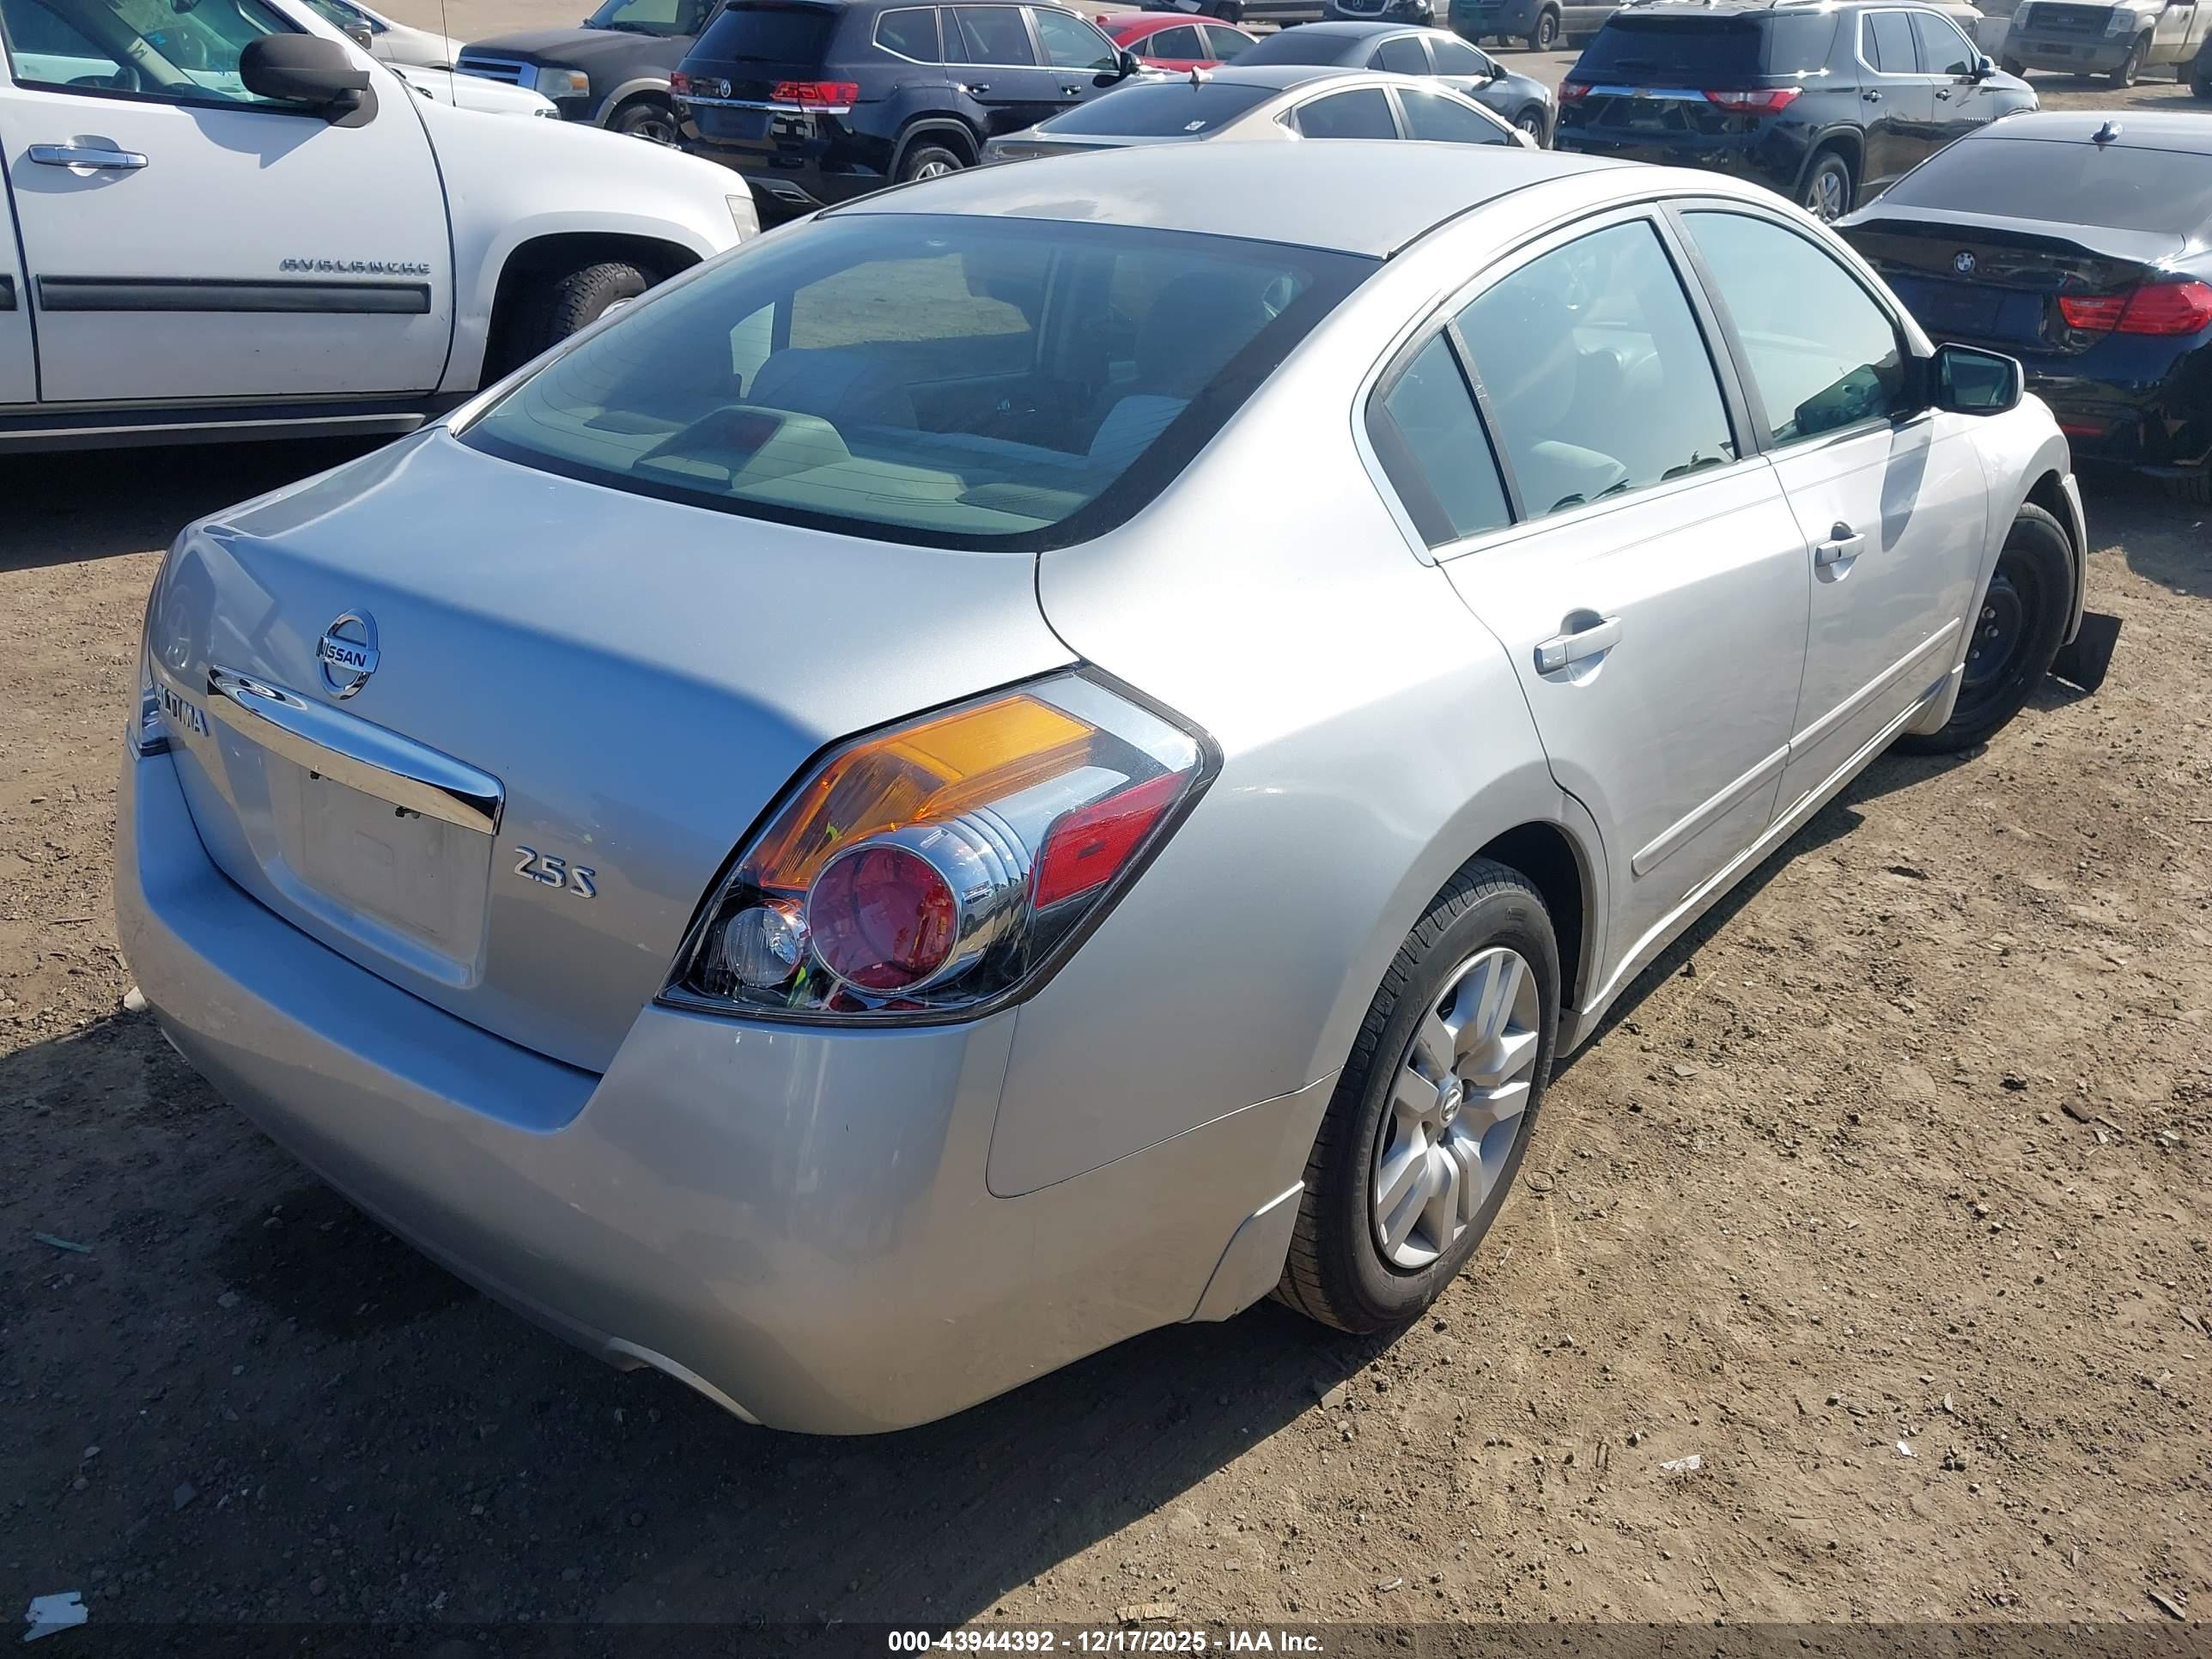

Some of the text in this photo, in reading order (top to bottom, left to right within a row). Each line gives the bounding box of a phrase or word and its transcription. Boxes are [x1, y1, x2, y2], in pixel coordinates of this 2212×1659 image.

[281, 258, 431, 276] AVALANCHE
[317, 635, 368, 667] NISSAN
[157, 684, 209, 736] ALTIMA
[514, 846, 596, 899] 2.5 S
